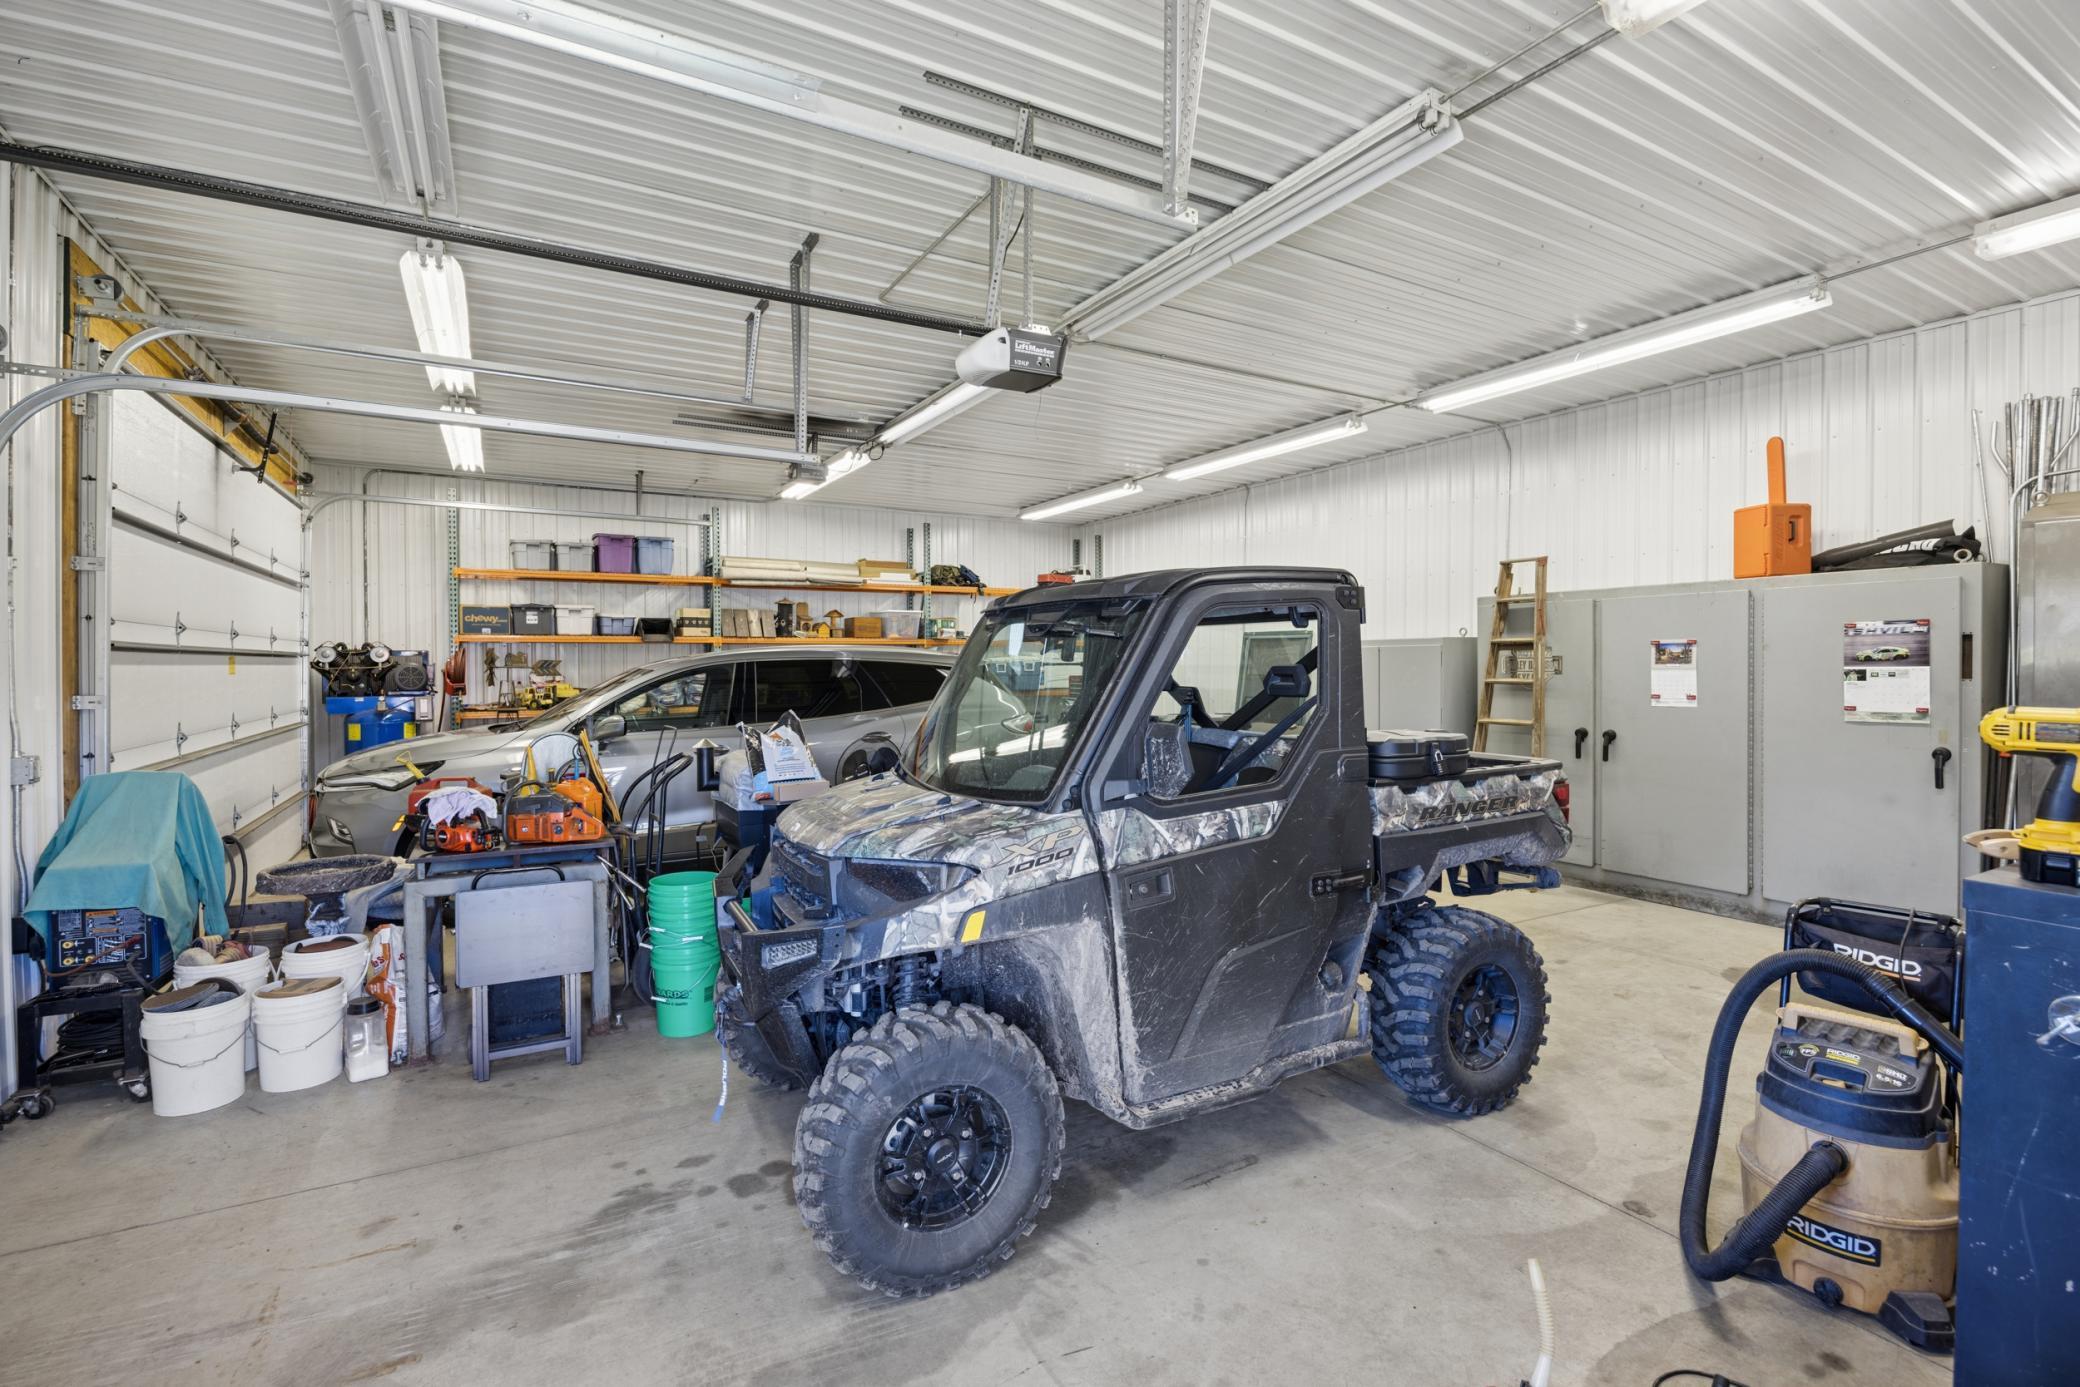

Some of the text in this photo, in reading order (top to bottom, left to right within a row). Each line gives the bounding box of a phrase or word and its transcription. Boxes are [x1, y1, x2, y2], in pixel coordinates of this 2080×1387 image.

[1015, 342, 1055, 355] LiftMaster
[464, 614, 498, 624] chewy
[1420, 796, 1518, 819] RANGER
[992, 825, 1083, 867] XP
[1008, 847, 1074, 875] 1000
[1826, 1048, 1860, 1060] RIDGID
[1787, 1215, 1877, 1256] RIDGID
